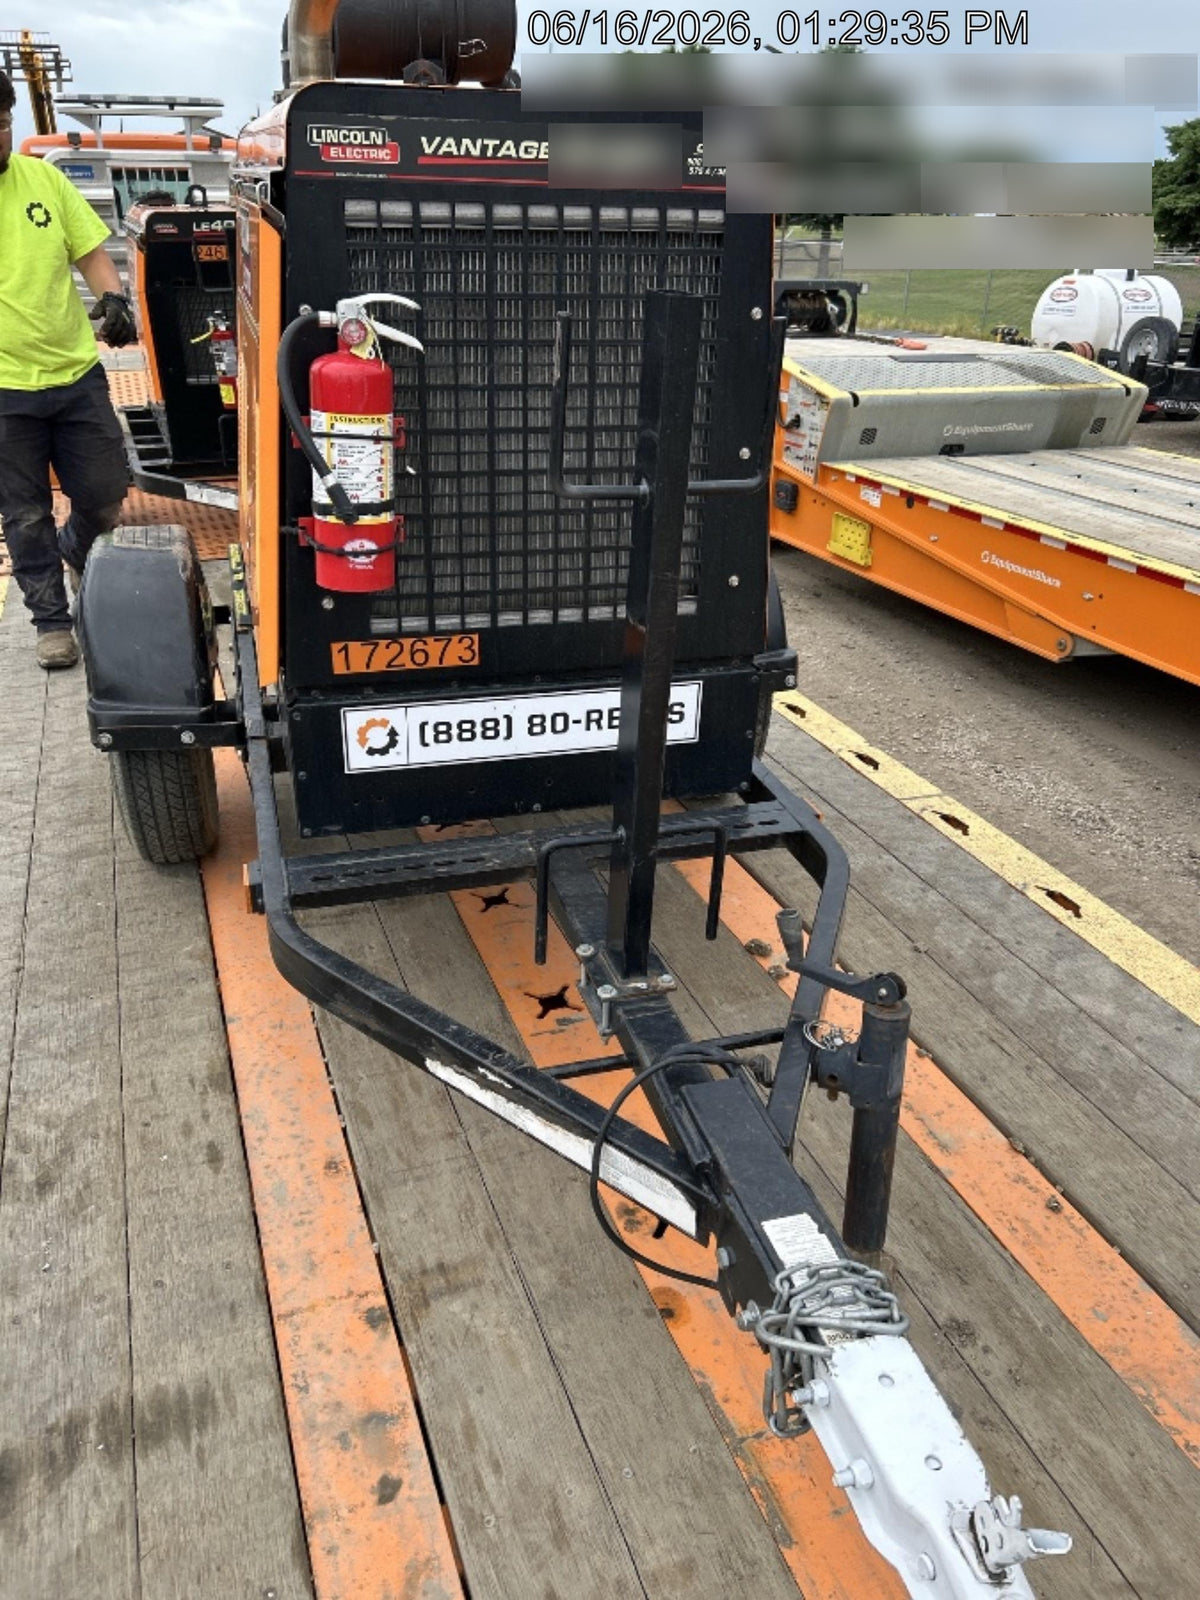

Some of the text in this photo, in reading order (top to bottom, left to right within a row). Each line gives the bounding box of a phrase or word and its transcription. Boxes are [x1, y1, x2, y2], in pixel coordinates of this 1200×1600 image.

[312, 128, 383, 145] LINCOLN
[329, 146, 392, 160] ELECTRIC
[337, 636, 476, 671] 172673
[527, 702, 685, 736] 80-RES
